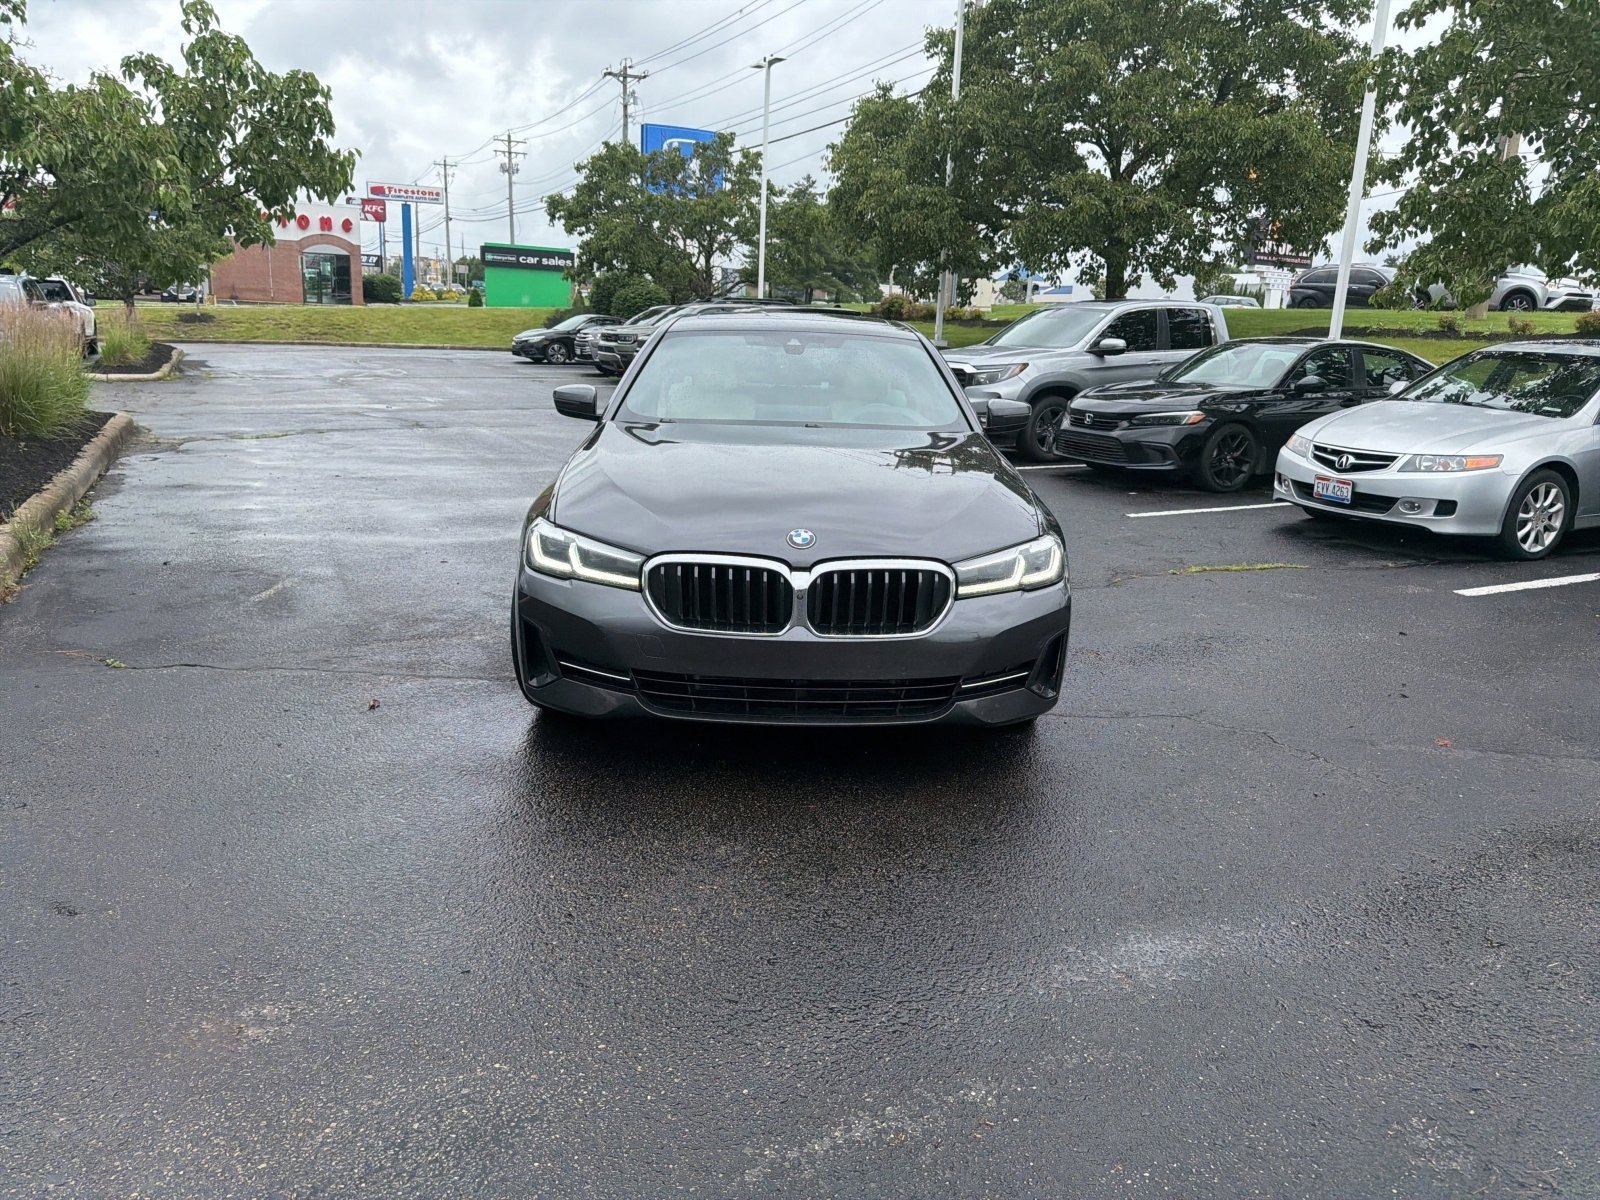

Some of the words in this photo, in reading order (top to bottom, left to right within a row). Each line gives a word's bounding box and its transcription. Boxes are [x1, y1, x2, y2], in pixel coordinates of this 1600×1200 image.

[386, 186, 440, 197] Firestone
[364, 204, 384, 213] KFC
[519, 256, 539, 264] car
[541, 256, 573, 267] sales
[1332, 485, 1349, 498] 4263
